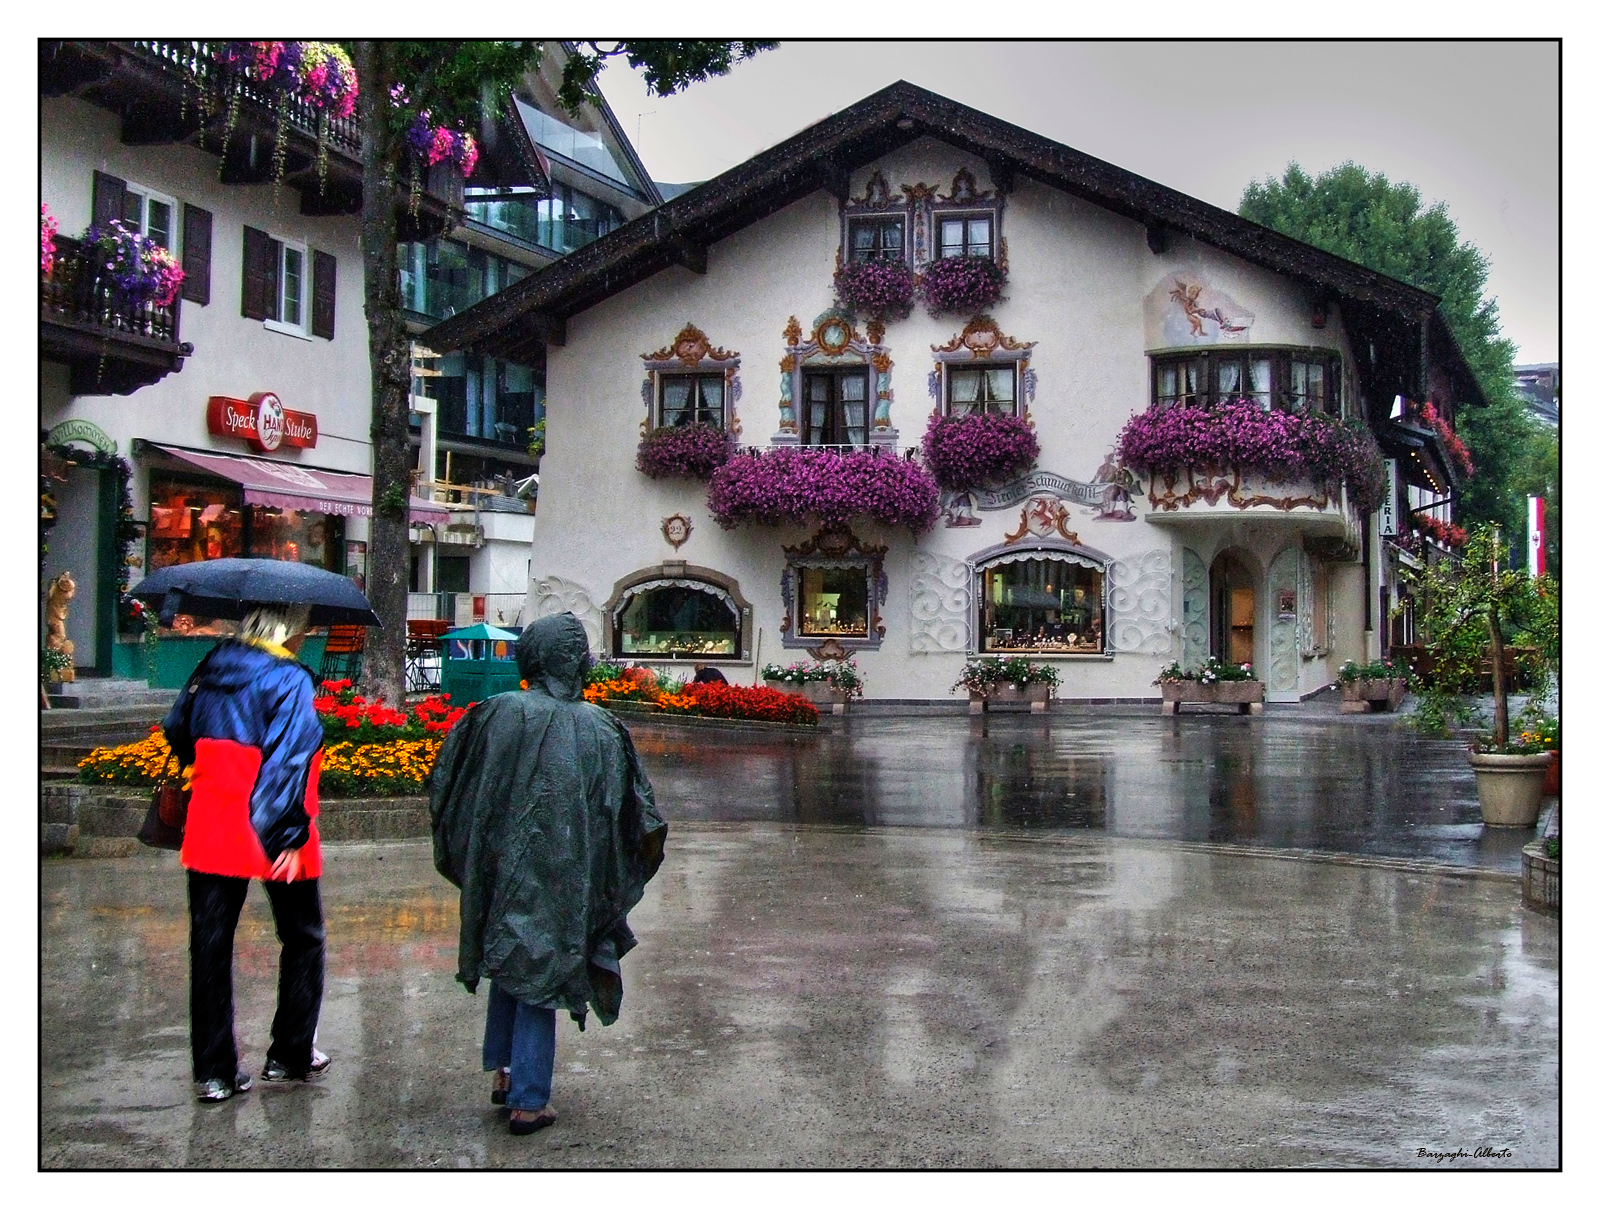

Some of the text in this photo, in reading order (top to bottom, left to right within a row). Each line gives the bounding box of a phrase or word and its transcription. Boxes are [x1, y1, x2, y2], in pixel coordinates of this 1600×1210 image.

[226, 406, 312, 440] Speck Stube
[319, 501, 332, 511] DER
[334, 503, 354, 515] ECHTE
[670, 526, 683, 535] 22
